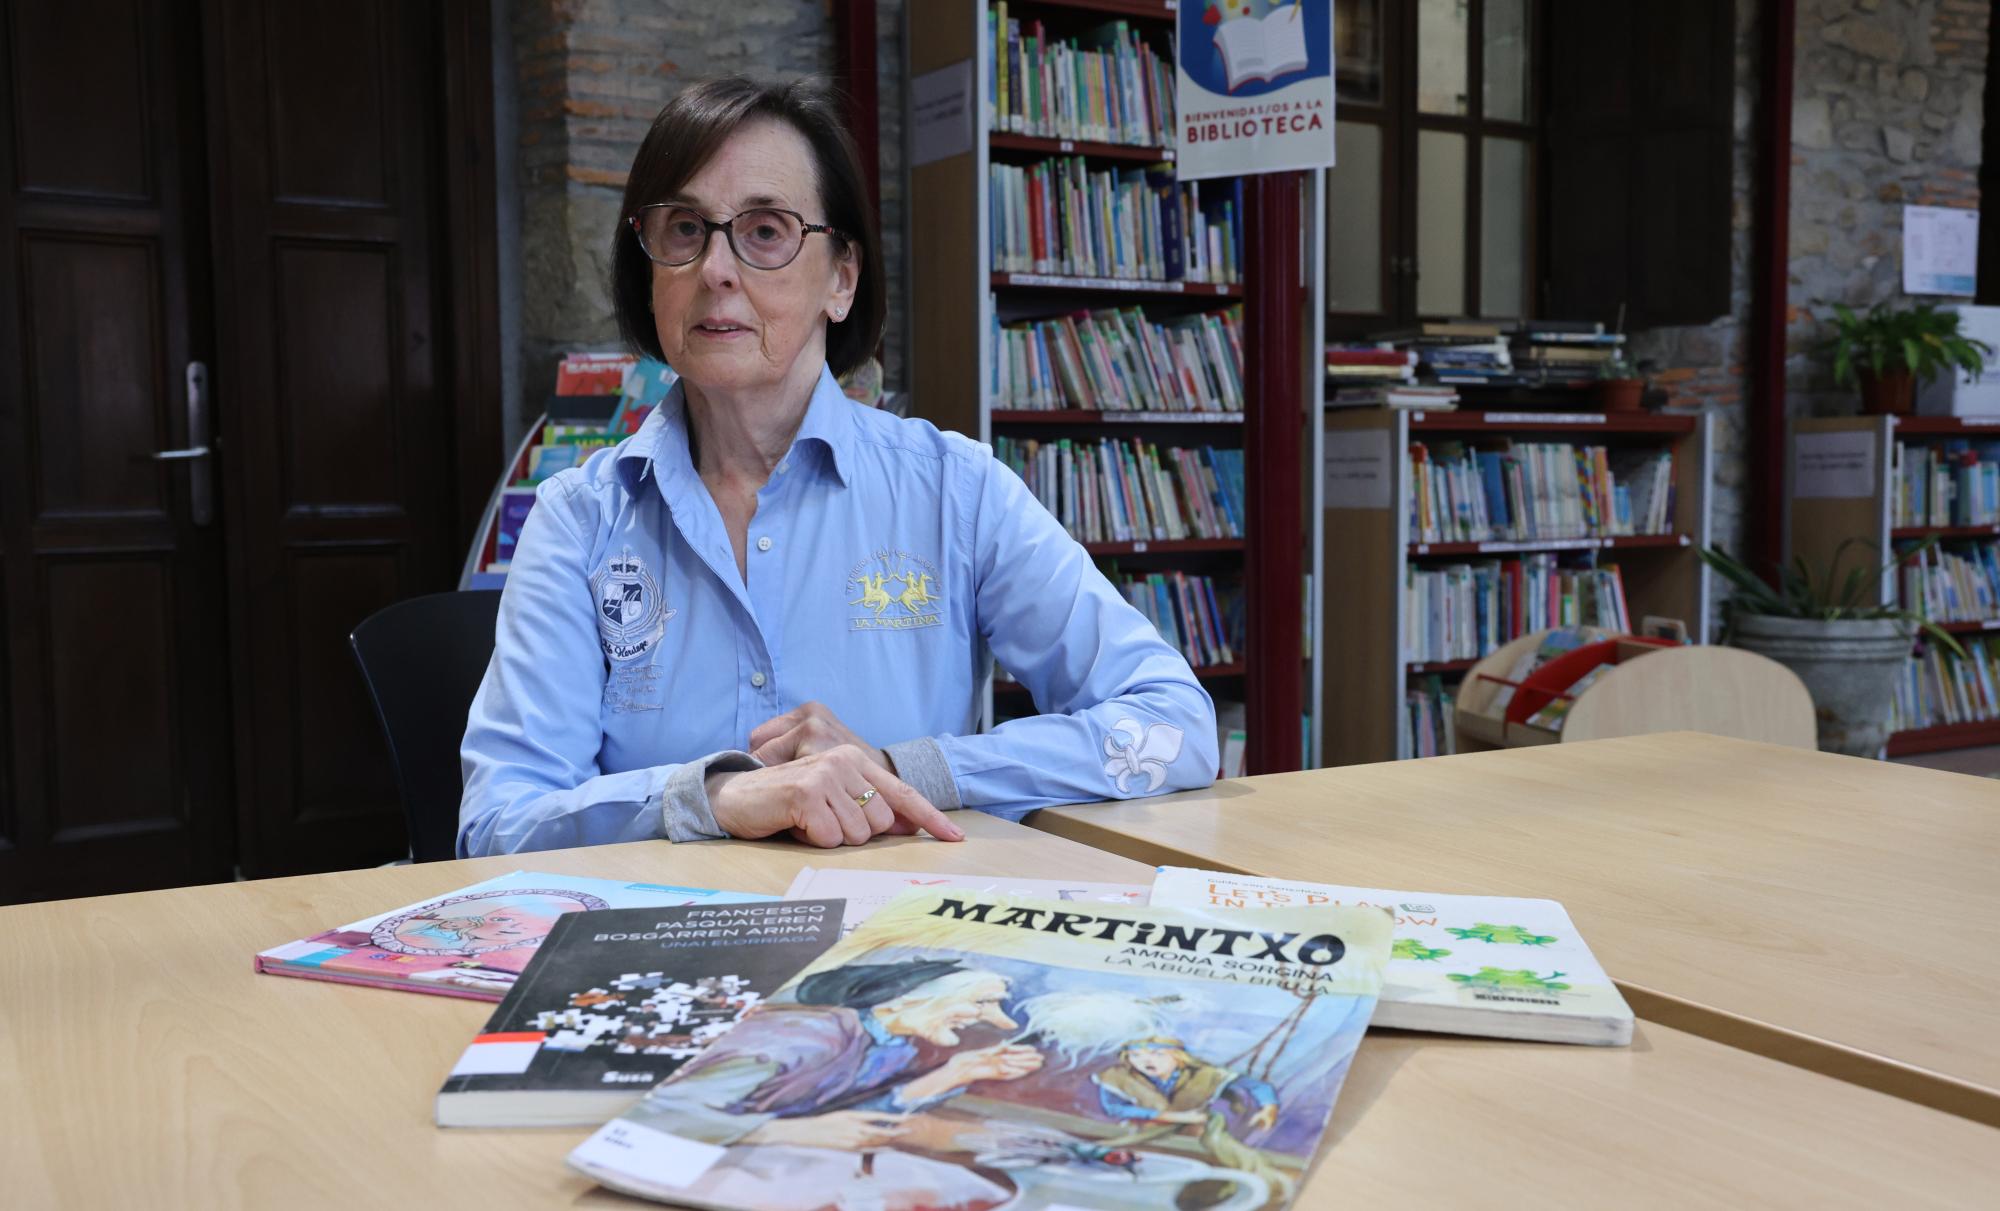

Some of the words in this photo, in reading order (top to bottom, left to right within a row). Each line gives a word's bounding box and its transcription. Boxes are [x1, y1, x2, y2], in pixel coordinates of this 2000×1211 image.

[1184, 103, 1289, 123] BIENVENIDAS/OS
[1294, 101, 1303, 110] A
[1306, 99, 1323, 110] LA
[1187, 113, 1323, 143] BIBLIOTECA
[1208, 896, 1245, 908] IN
[687, 904, 827, 919] FRANCESCO
[655, 915, 824, 930] PASQUALEREN
[593, 928, 739, 942] BOSGARREN
[746, 924, 821, 936] ARIMA
[660, 939, 706, 950] UNAI
[711, 935, 819, 947] ELORRIAGA
[1119, 946, 1214, 966] AMONA
[1223, 959, 1334, 983] SORGINA
[1104, 955, 1134, 966] LA
[1137, 961, 1238, 983] ABUELA
[1249, 975, 1331, 996] BRUJA
[601, 1070, 654, 1083] Susa
